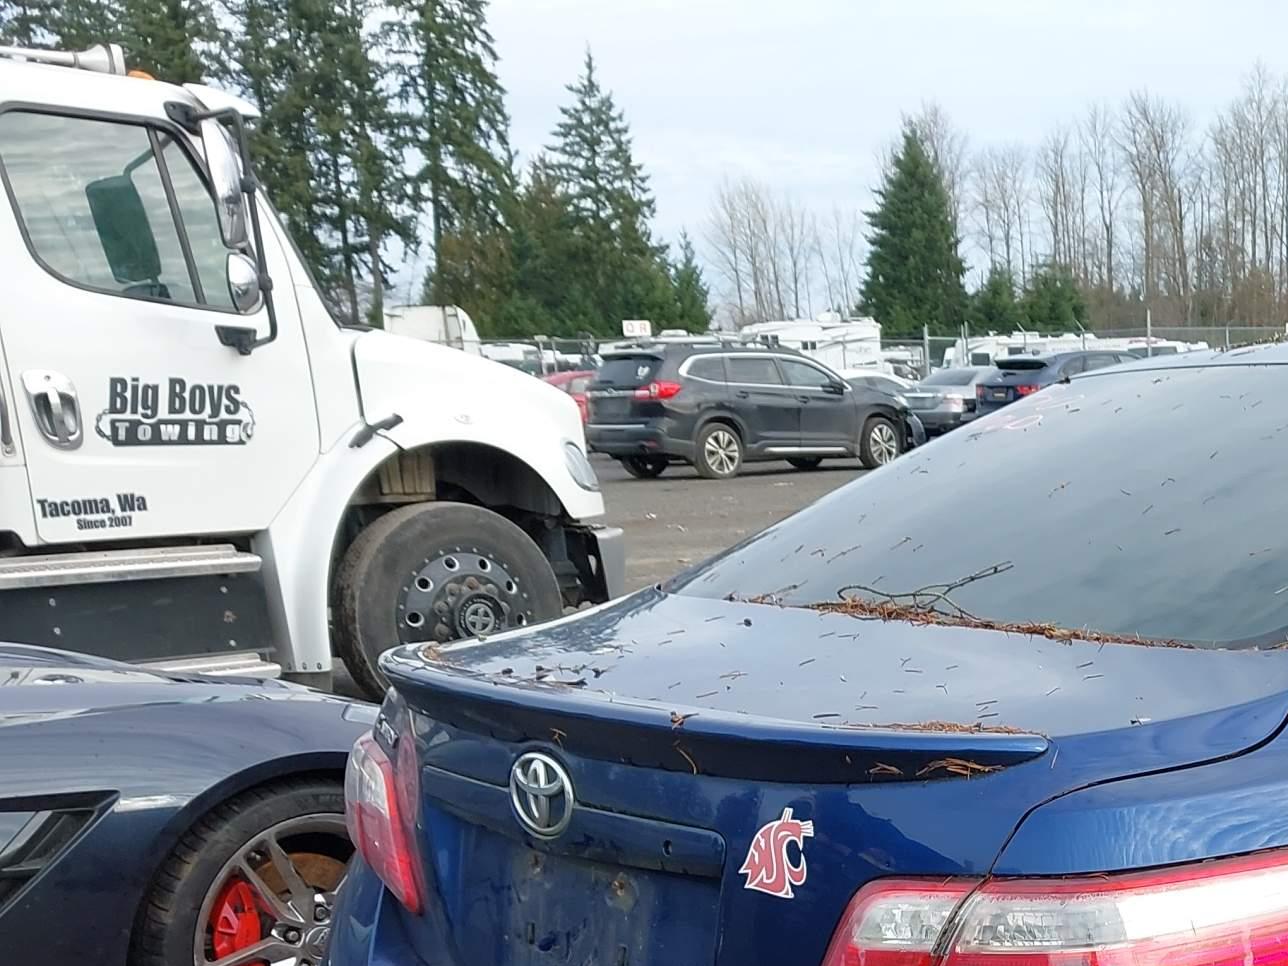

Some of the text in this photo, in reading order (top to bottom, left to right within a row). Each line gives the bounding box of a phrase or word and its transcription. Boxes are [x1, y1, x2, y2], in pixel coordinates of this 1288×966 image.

[109, 377, 240, 419] Big Boys
[115, 421, 241, 443] Towing
[36, 493, 147, 518] Tacoma, Wa
[76, 516, 132, 530] Since 2007
